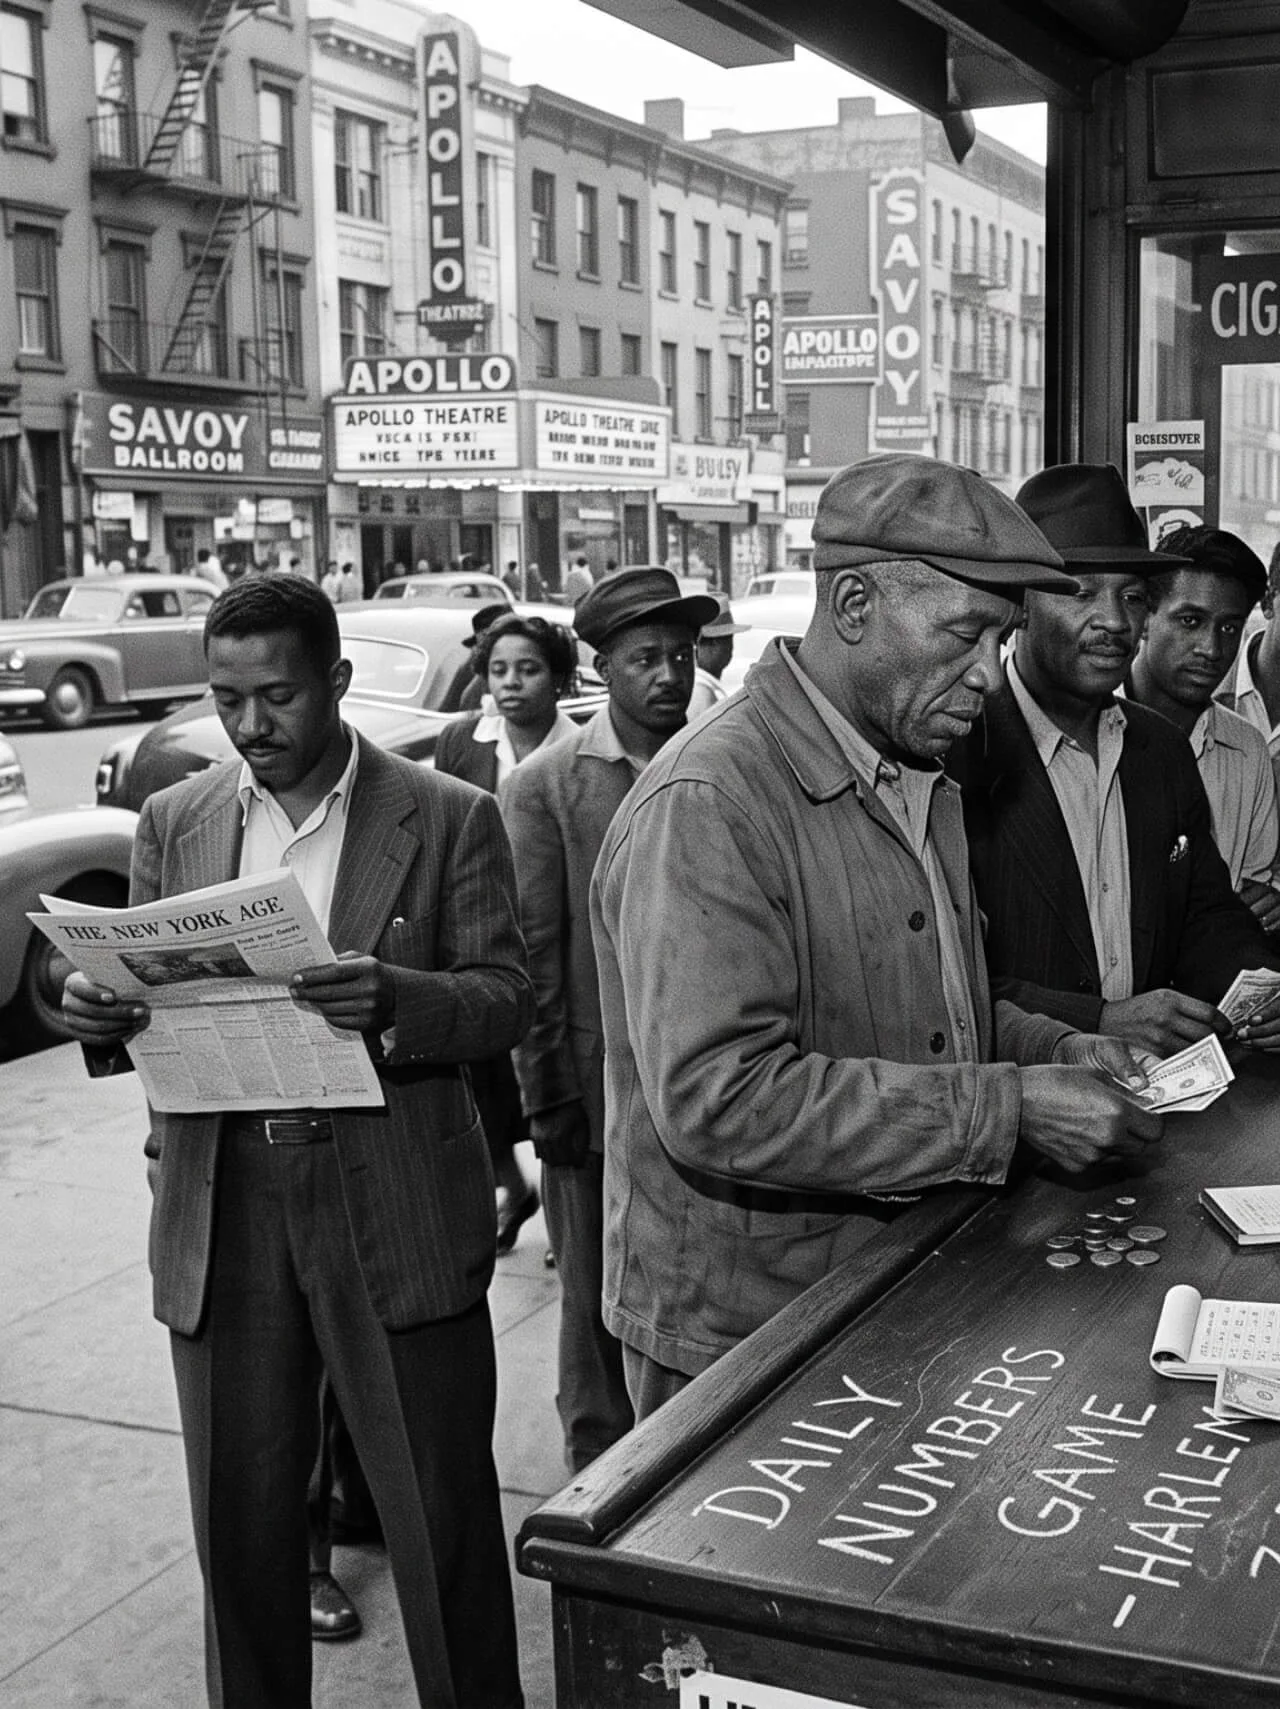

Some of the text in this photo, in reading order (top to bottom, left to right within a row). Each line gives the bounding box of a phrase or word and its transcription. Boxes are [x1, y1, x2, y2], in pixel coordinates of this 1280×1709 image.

[426, 40, 463, 293] APOLLO
[884, 189, 921, 405] SAVOY
[754, 300, 771, 410] APOLL
[783, 328, 877, 354] APOLLO
[348, 357, 511, 394] APOLLO
[108, 403, 249, 449] SAVOY
[345, 407, 508, 427] APOLLO THEATRE
[544, 408, 587, 427] APOLLO
[114, 445, 244, 471] BALLROOM
[58, 896, 285, 940] THE NEW YORK AGE
[691, 1375, 903, 1530] DAILY
[817, 1346, 1065, 1565] NUMBERS
[997, 1394, 1157, 1537] GAME
